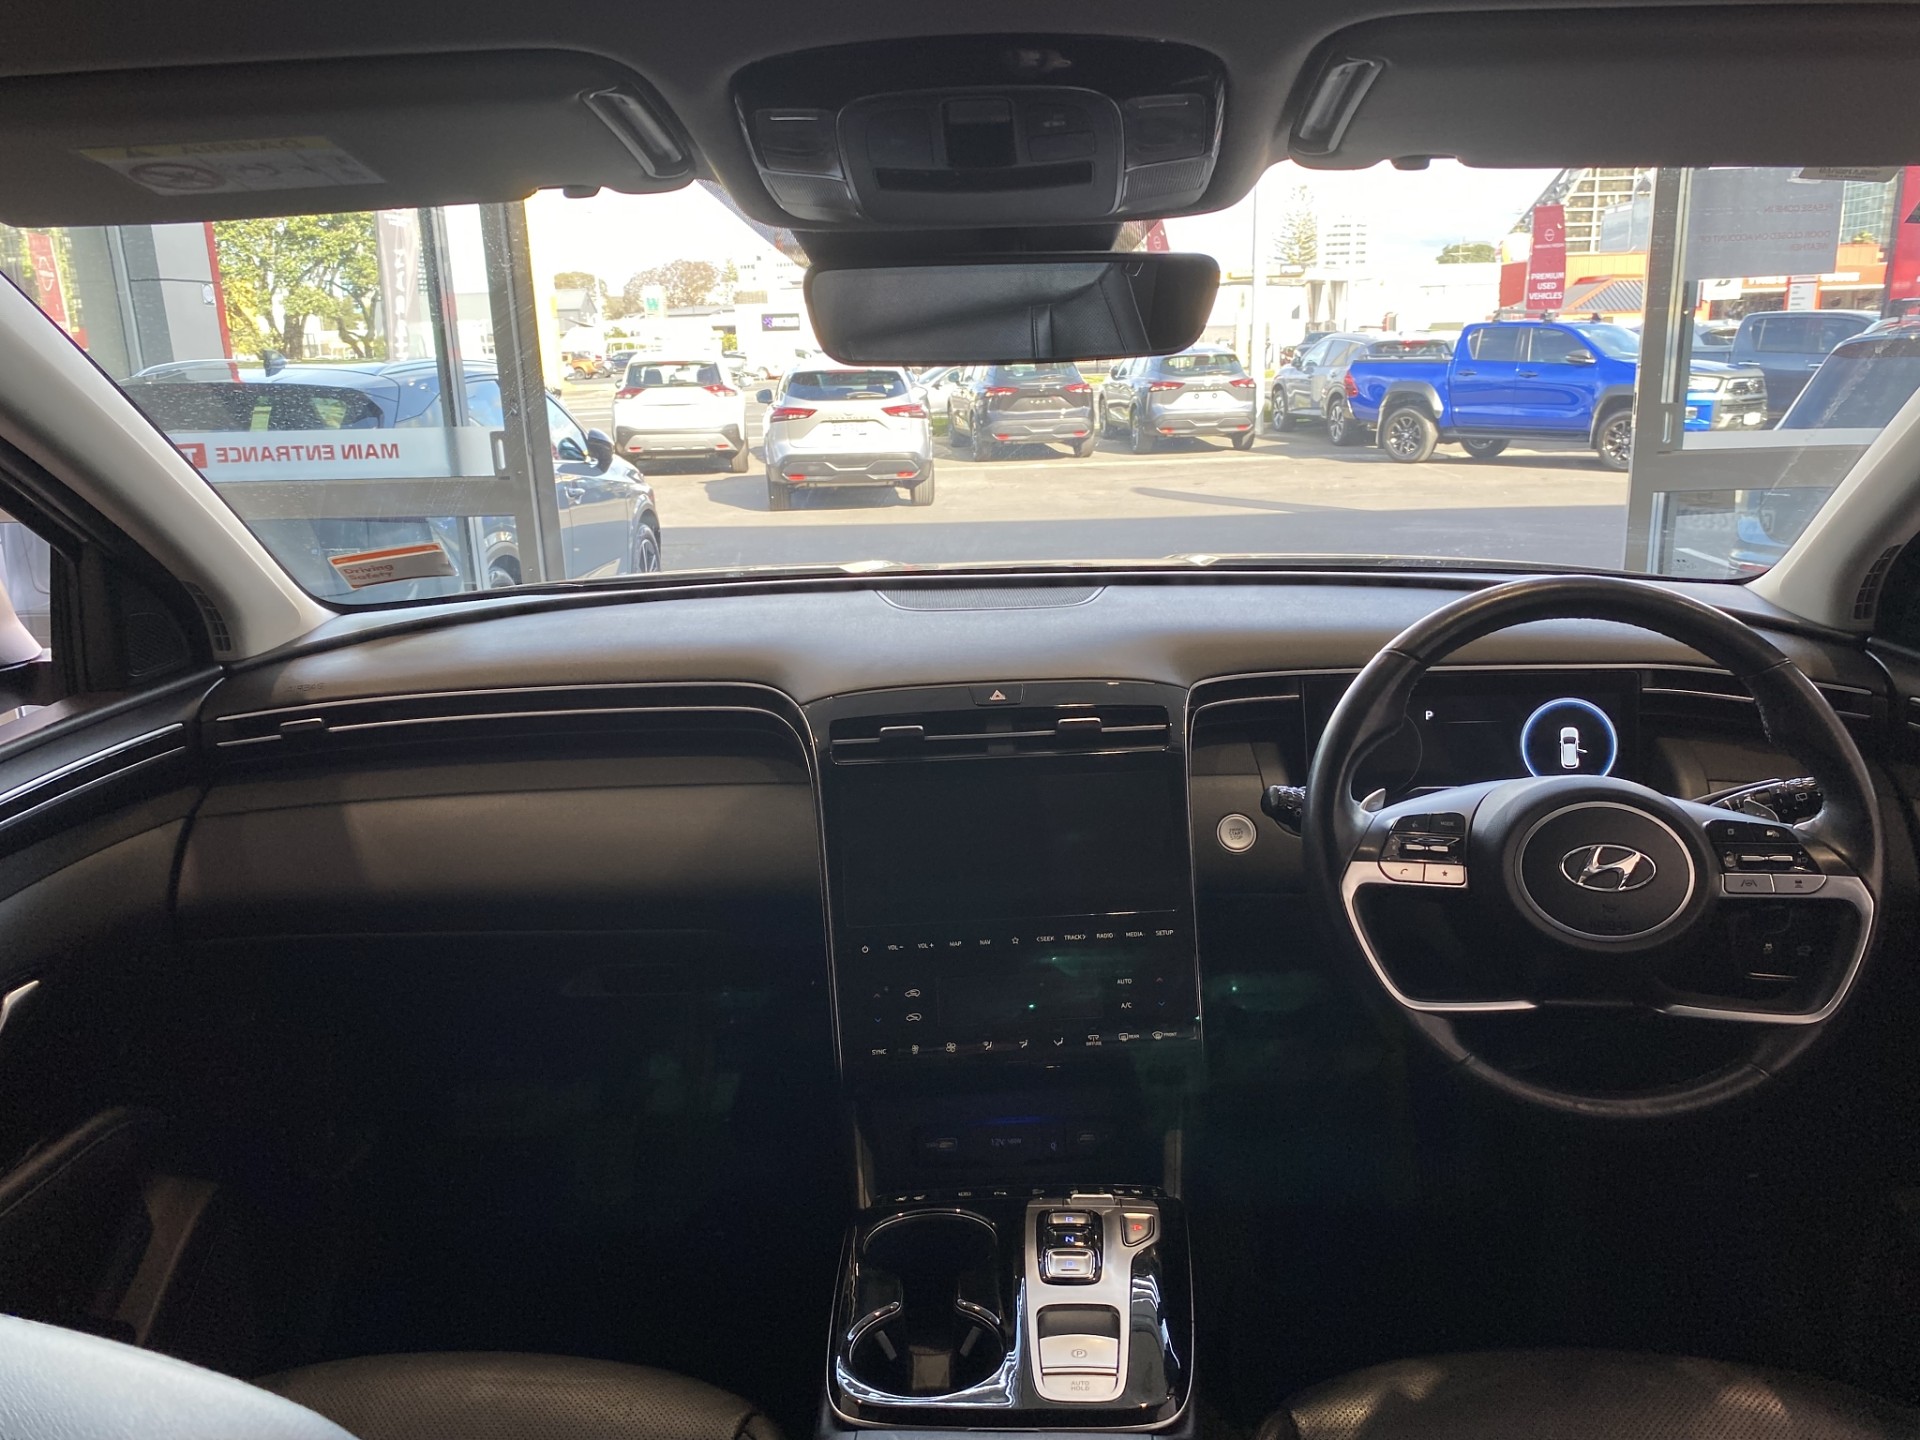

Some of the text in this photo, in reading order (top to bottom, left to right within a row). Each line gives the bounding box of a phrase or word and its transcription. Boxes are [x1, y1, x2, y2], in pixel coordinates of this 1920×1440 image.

[1531, 271, 1564, 281] PREMIUM
[1537, 282, 1557, 290] USED
[1529, 291, 1563, 300] VEHICLES
[344, 563, 394, 575] Driving
[348, 570, 393, 582] Safety
[1425, 710, 1434, 720] P
[1096, 932, 1114, 940] RADIO
[1125, 930, 1144, 938] MEDIA
[1155, 929, 1174, 937] SETUP
[979, 938, 991, 946] NAV
[871, 1048, 888, 1056] SYNC
